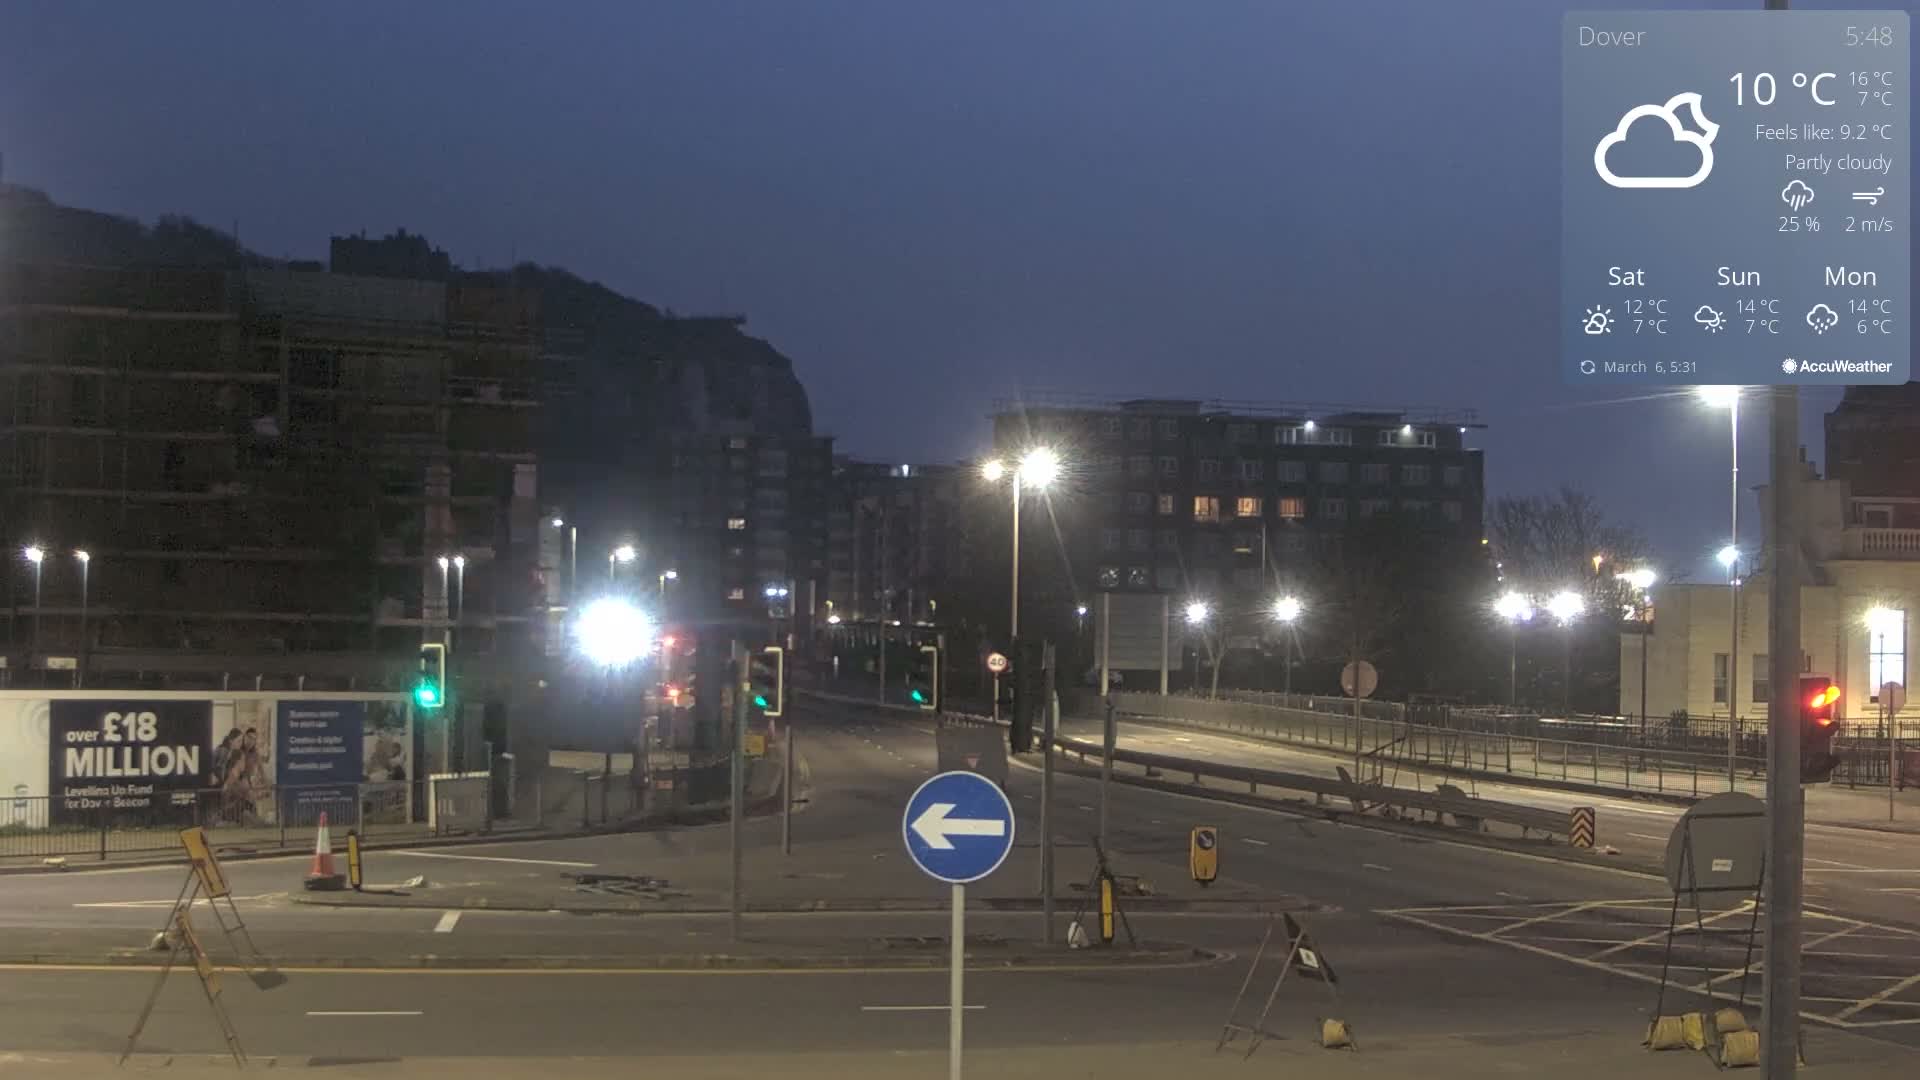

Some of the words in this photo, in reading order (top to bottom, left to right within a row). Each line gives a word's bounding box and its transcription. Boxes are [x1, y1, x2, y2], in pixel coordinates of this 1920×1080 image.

[66, 731, 99, 742] over
[104, 711, 158, 742] £18
[66, 746, 199, 777] MILLION
[111, 785, 126, 797] Up
[128, 784, 153, 795] Fund
[113, 797, 150, 808] Beacon
